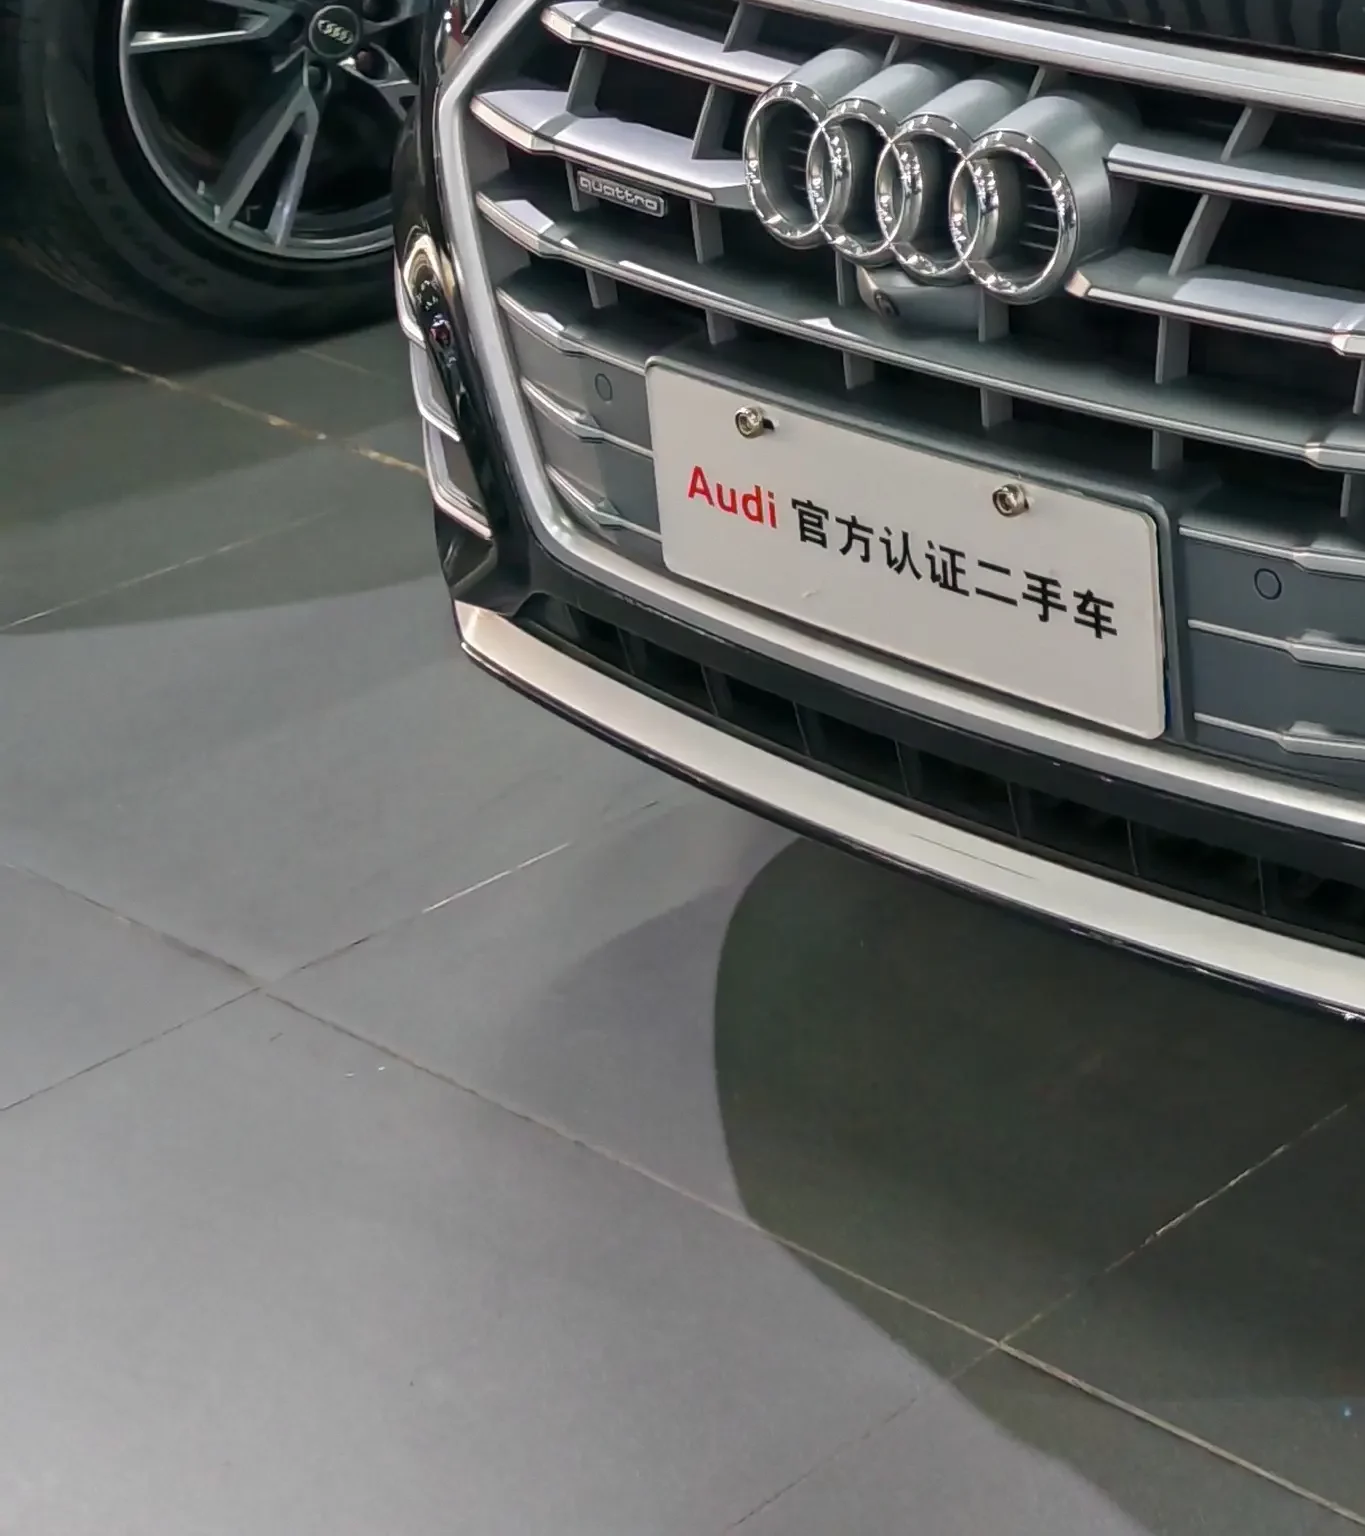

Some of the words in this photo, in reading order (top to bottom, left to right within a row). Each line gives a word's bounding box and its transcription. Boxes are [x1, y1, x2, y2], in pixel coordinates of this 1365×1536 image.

[579, 176, 658, 211] quattro
[687, 465, 779, 529] Audi
[790, 498, 1118, 640] 官方认证二手车
